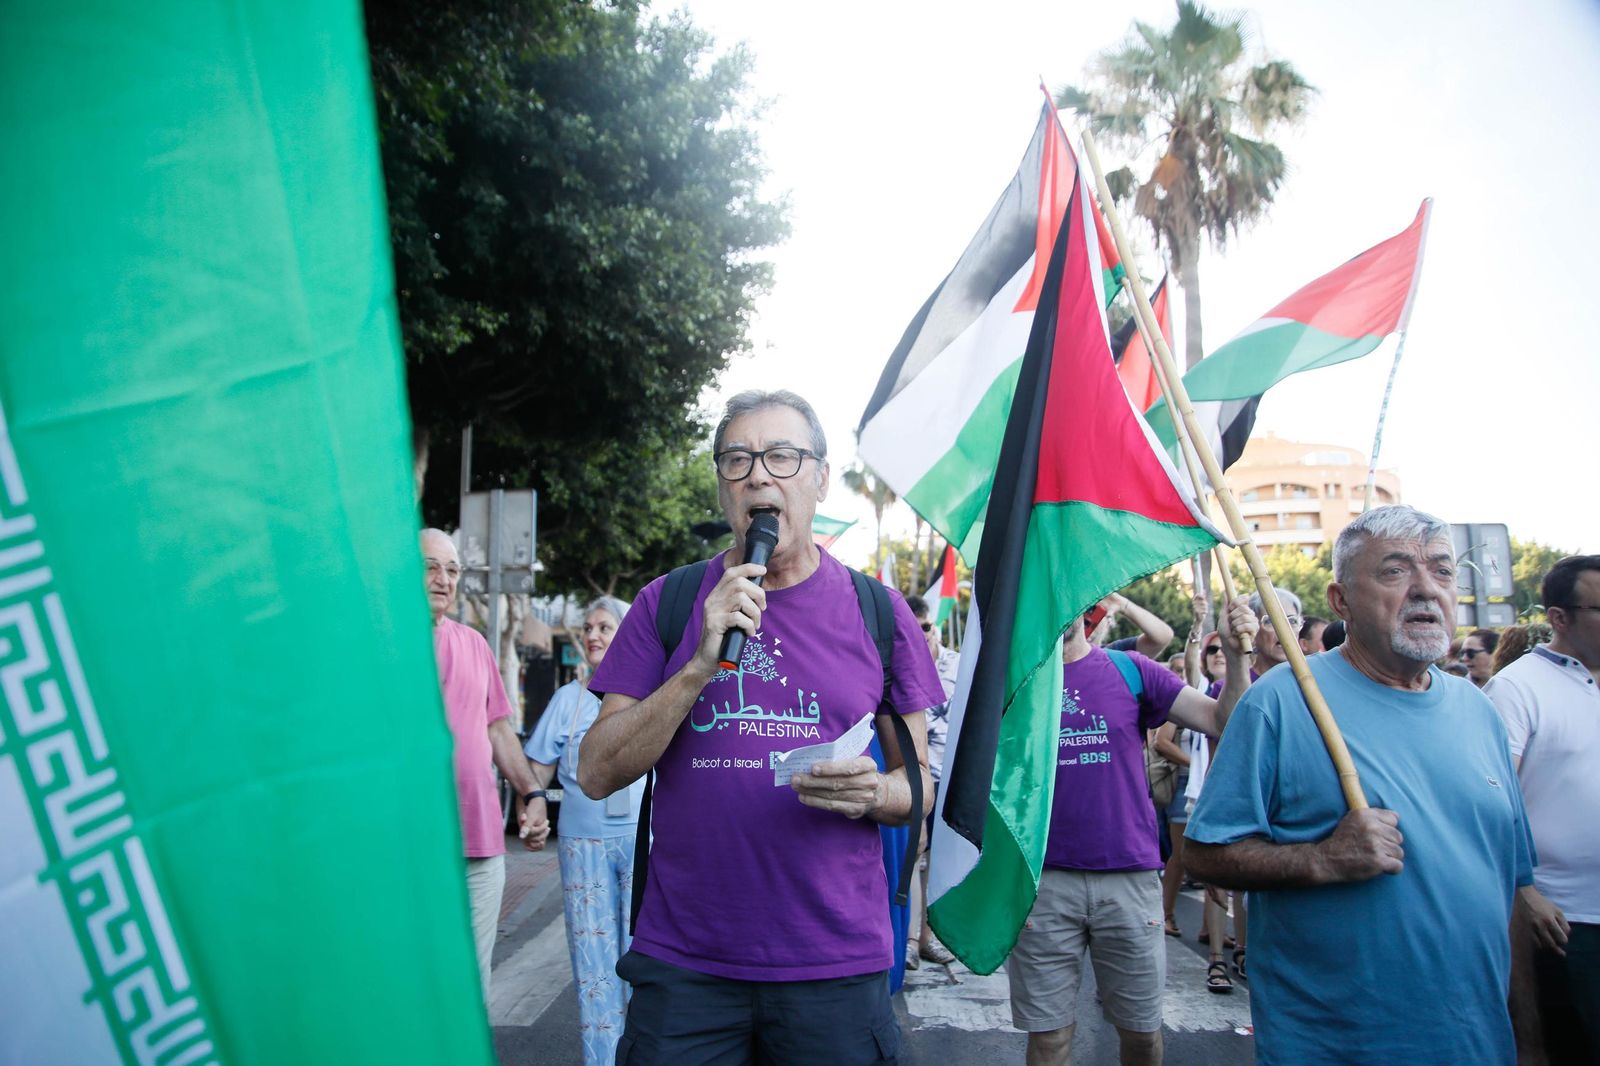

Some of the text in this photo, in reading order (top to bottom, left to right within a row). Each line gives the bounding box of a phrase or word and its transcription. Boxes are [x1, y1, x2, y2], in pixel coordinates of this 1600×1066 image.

[690, 684, 821, 732] فلسطين
[738, 721, 821, 739] PALESTINA
[1060, 735, 1109, 747] PALESTINA
[692, 757, 721, 769] Boicot
[723, 759, 732, 768] a
[734, 757, 763, 769] Israel
[1080, 752, 1111, 764] BDS!
